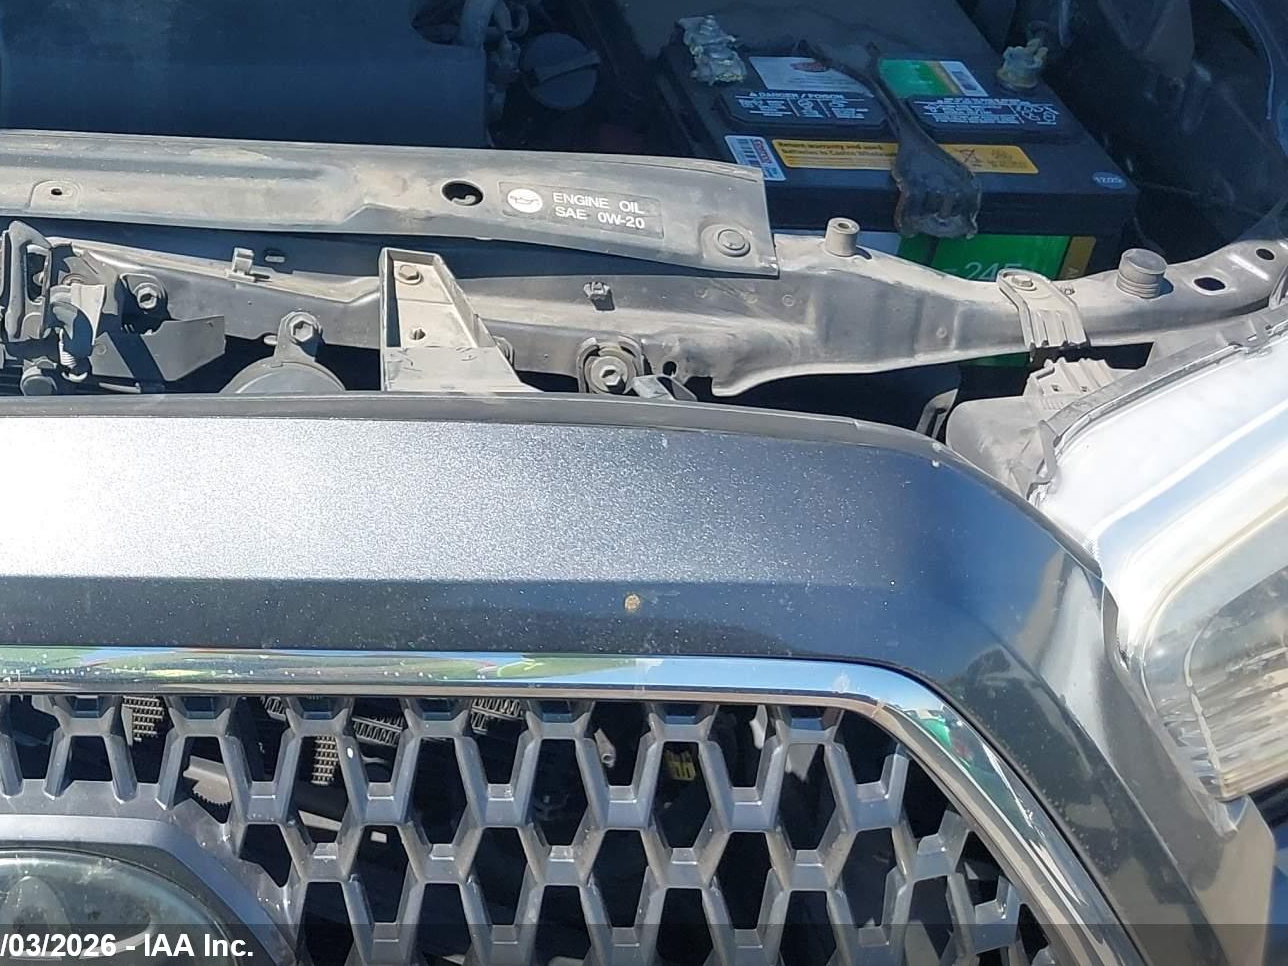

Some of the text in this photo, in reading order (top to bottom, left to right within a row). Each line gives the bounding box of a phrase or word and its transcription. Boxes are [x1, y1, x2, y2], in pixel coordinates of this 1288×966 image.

[552, 192, 645, 215] ENGINE OIL
[555, 206, 646, 230] SAE 0W-20
[965, 261, 1023, 281] 24
